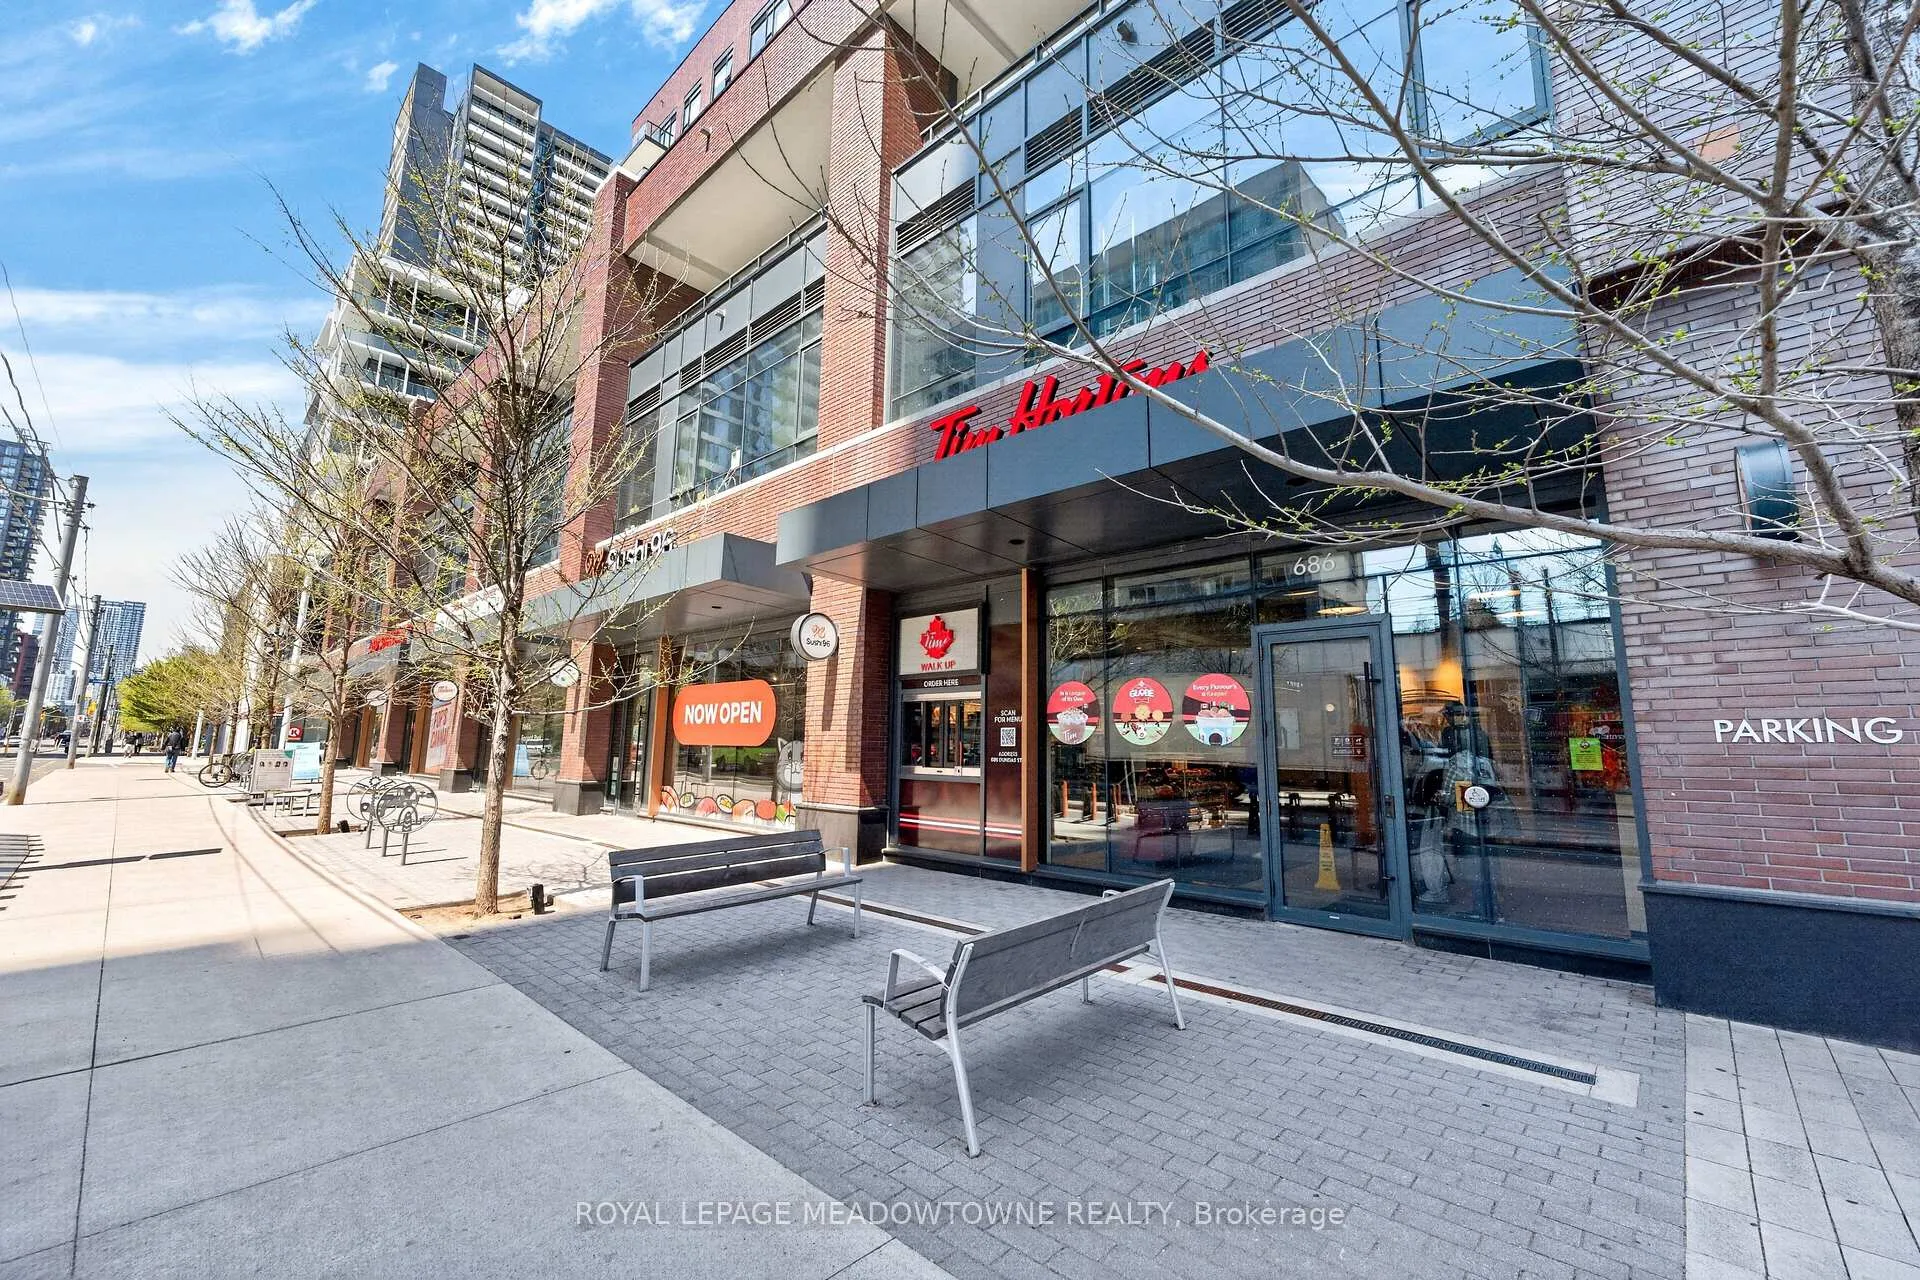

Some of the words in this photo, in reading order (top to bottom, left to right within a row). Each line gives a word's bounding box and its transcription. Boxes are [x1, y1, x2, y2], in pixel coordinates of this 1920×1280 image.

[930, 405, 1004, 463] Tim
[1293, 552, 1336, 576] 686
[920, 661, 943, 672] WALK
[944, 660, 957, 670] UP
[923, 680, 943, 688] ORDER
[684, 703, 719, 725] NOW
[719, 701, 763, 724] OPEN
[1713, 717, 1903, 744] PARKING
